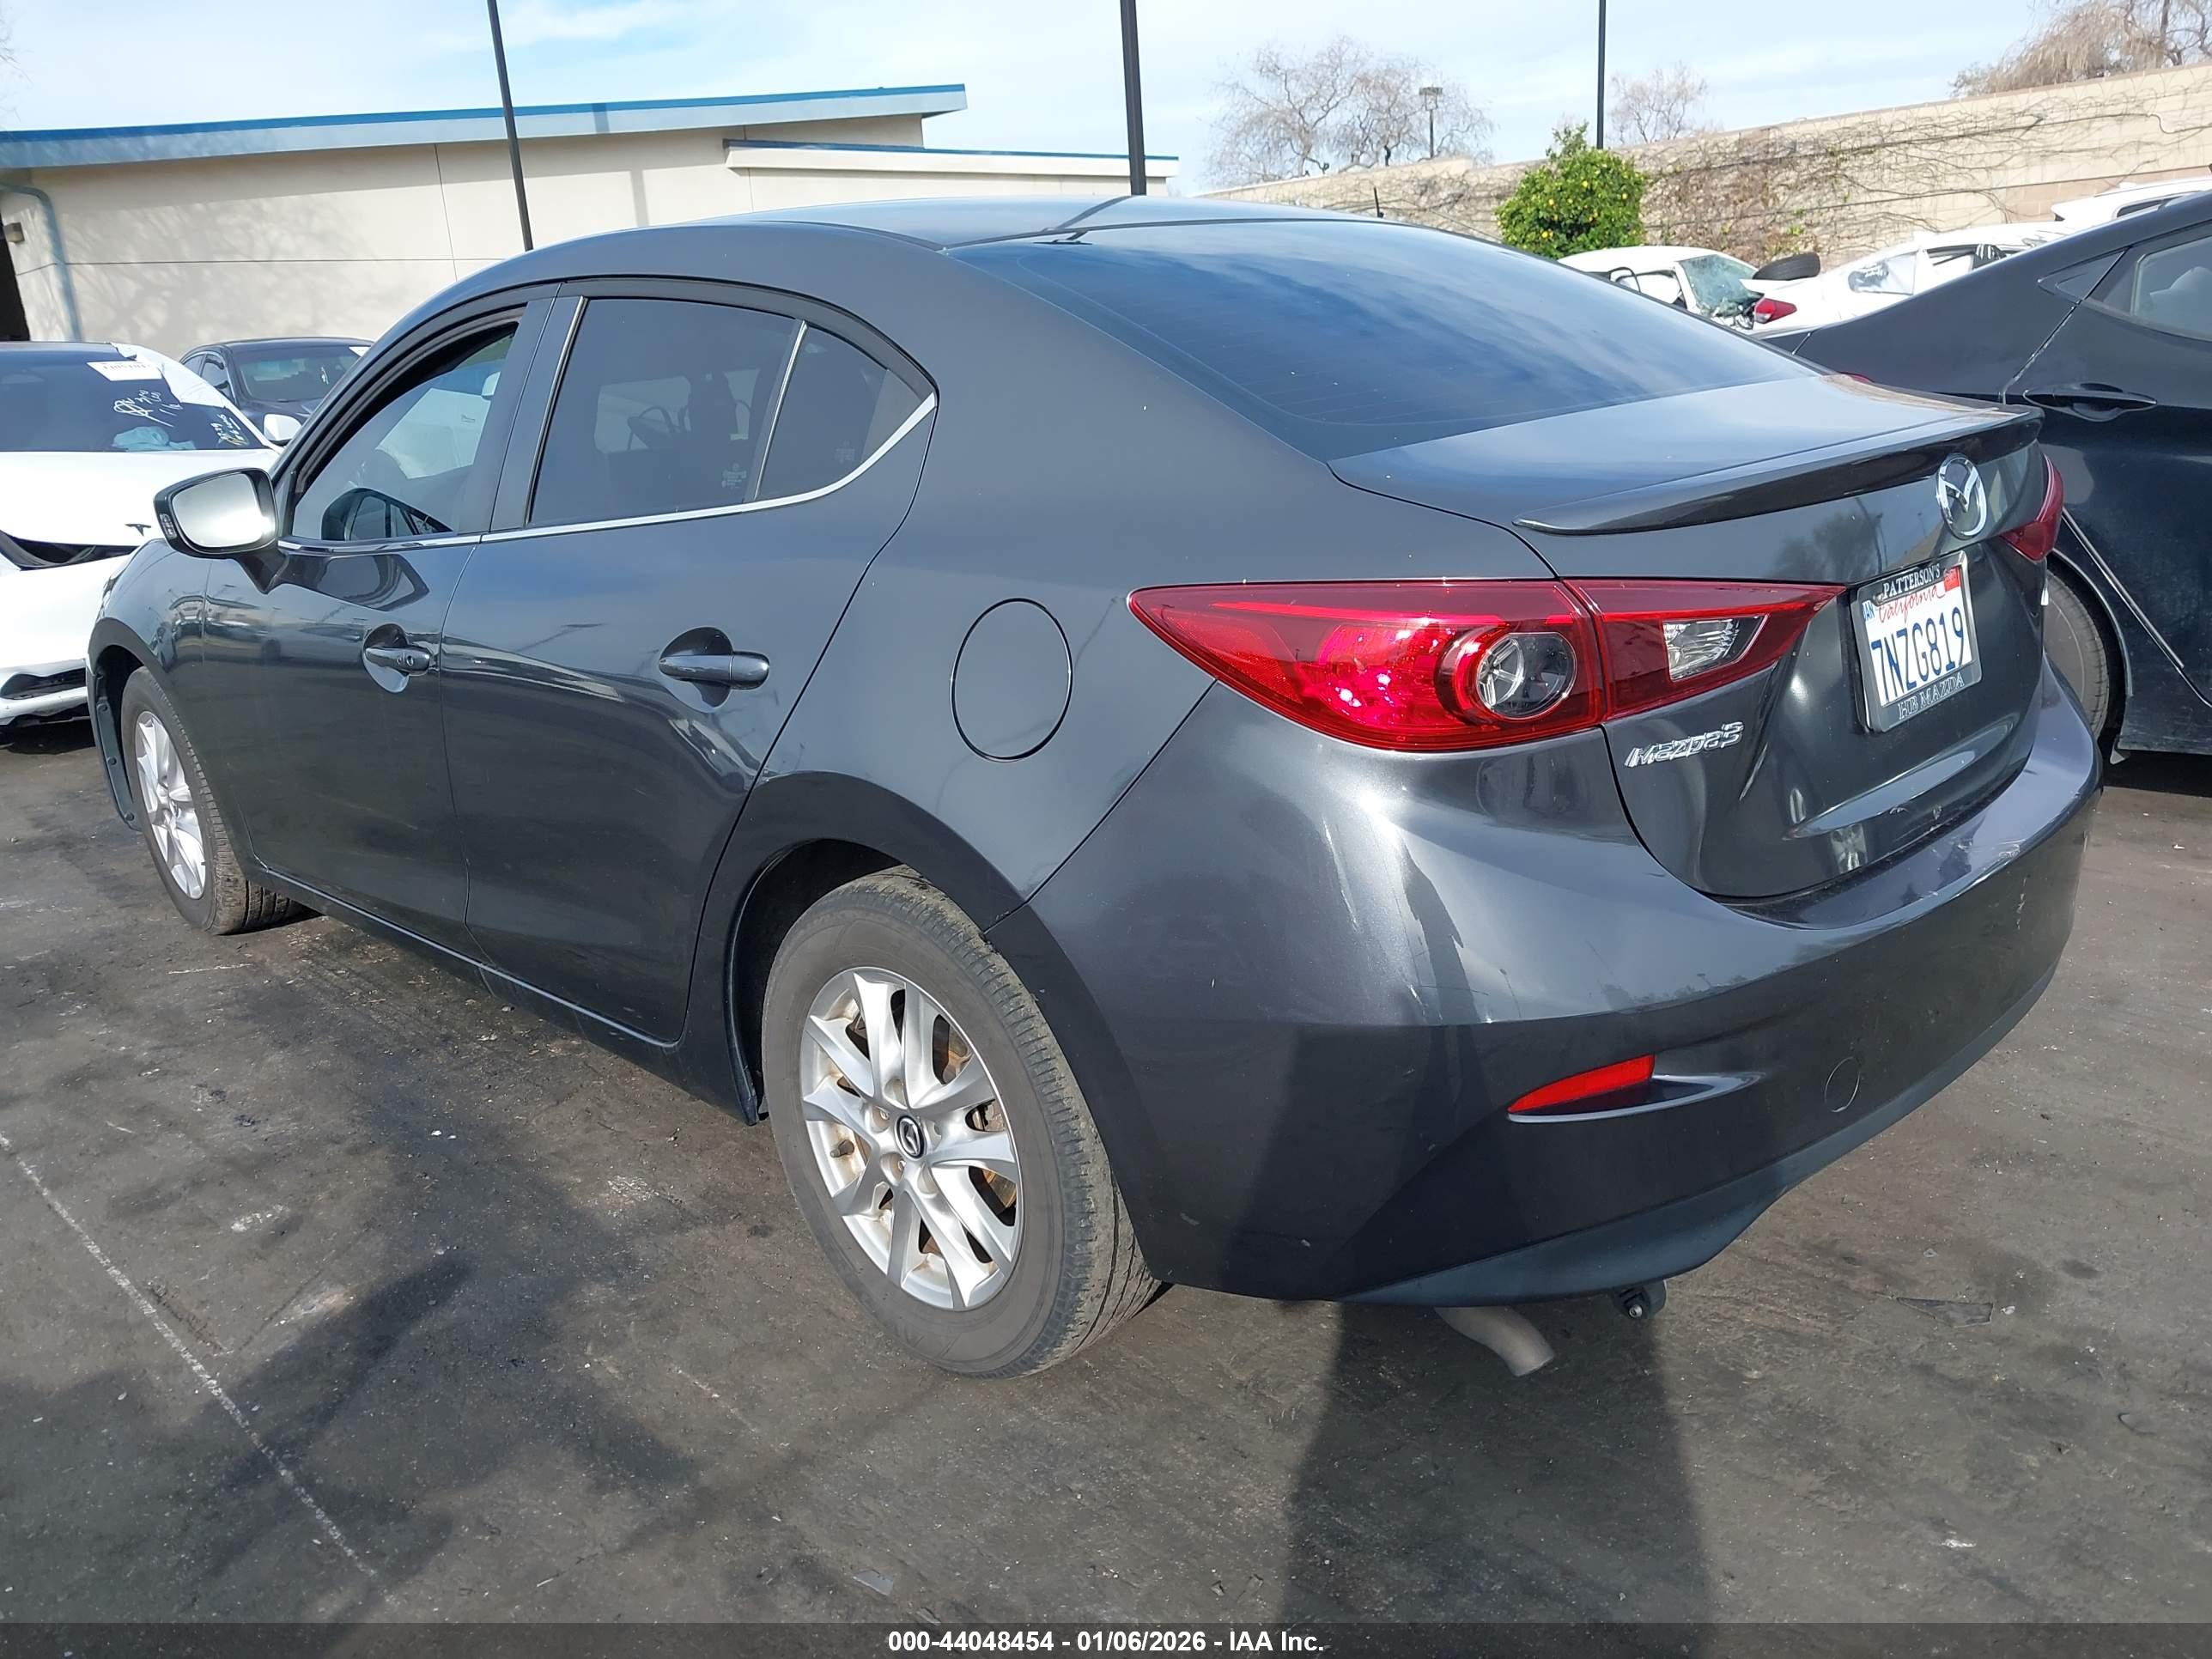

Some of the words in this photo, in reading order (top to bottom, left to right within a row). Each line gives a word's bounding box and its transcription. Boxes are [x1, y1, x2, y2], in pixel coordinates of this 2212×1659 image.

[1882, 562, 1941, 599] PATTERSON'S
[1879, 585, 1946, 624] California
[1870, 606, 1965, 704] 7NZG819
[1919, 672, 1966, 709] MAZDA
